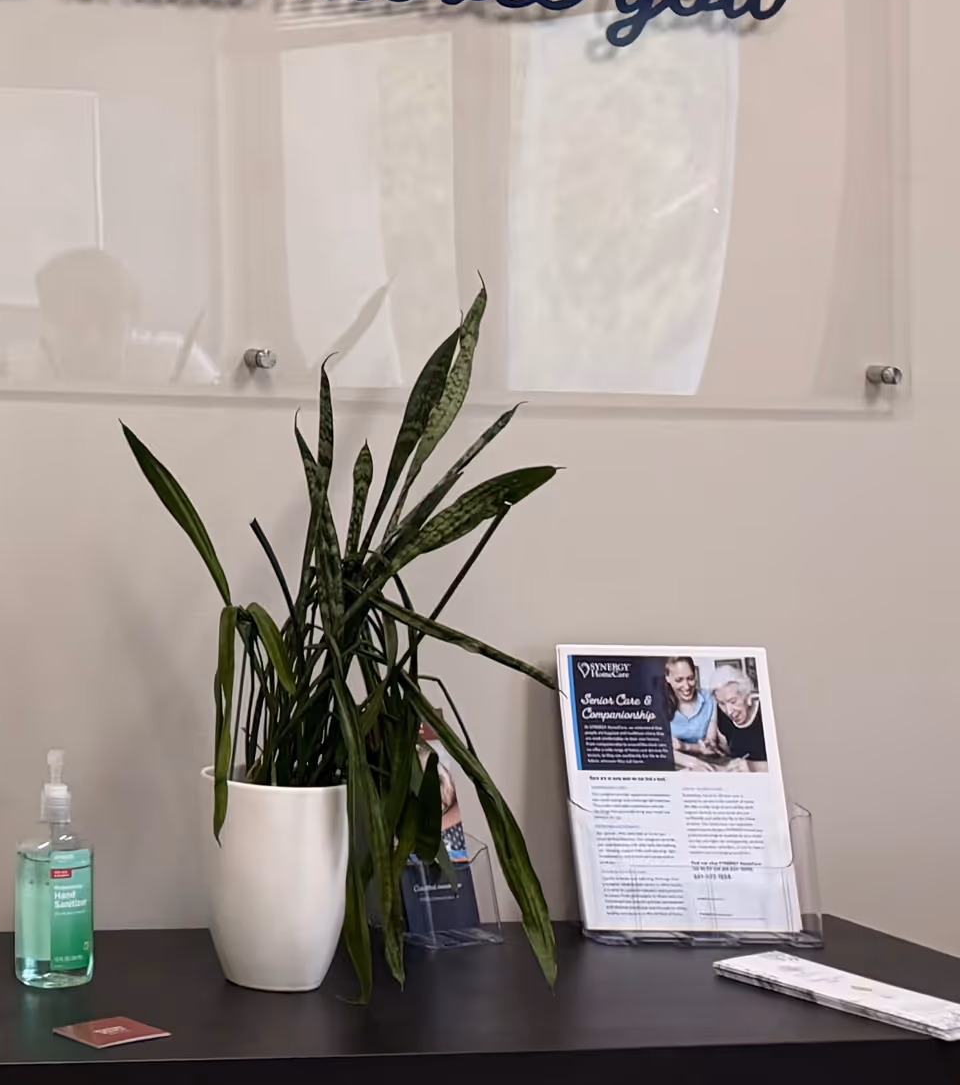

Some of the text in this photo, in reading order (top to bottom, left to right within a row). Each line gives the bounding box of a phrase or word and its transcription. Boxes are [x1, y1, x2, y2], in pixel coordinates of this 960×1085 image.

[580, 693, 615, 706] Senior
[615, 693, 641, 706] Care
[581, 707, 657, 723] Companionship
[54, 890, 77, 901] Hand
[53, 898, 88, 910] Sanitizer
